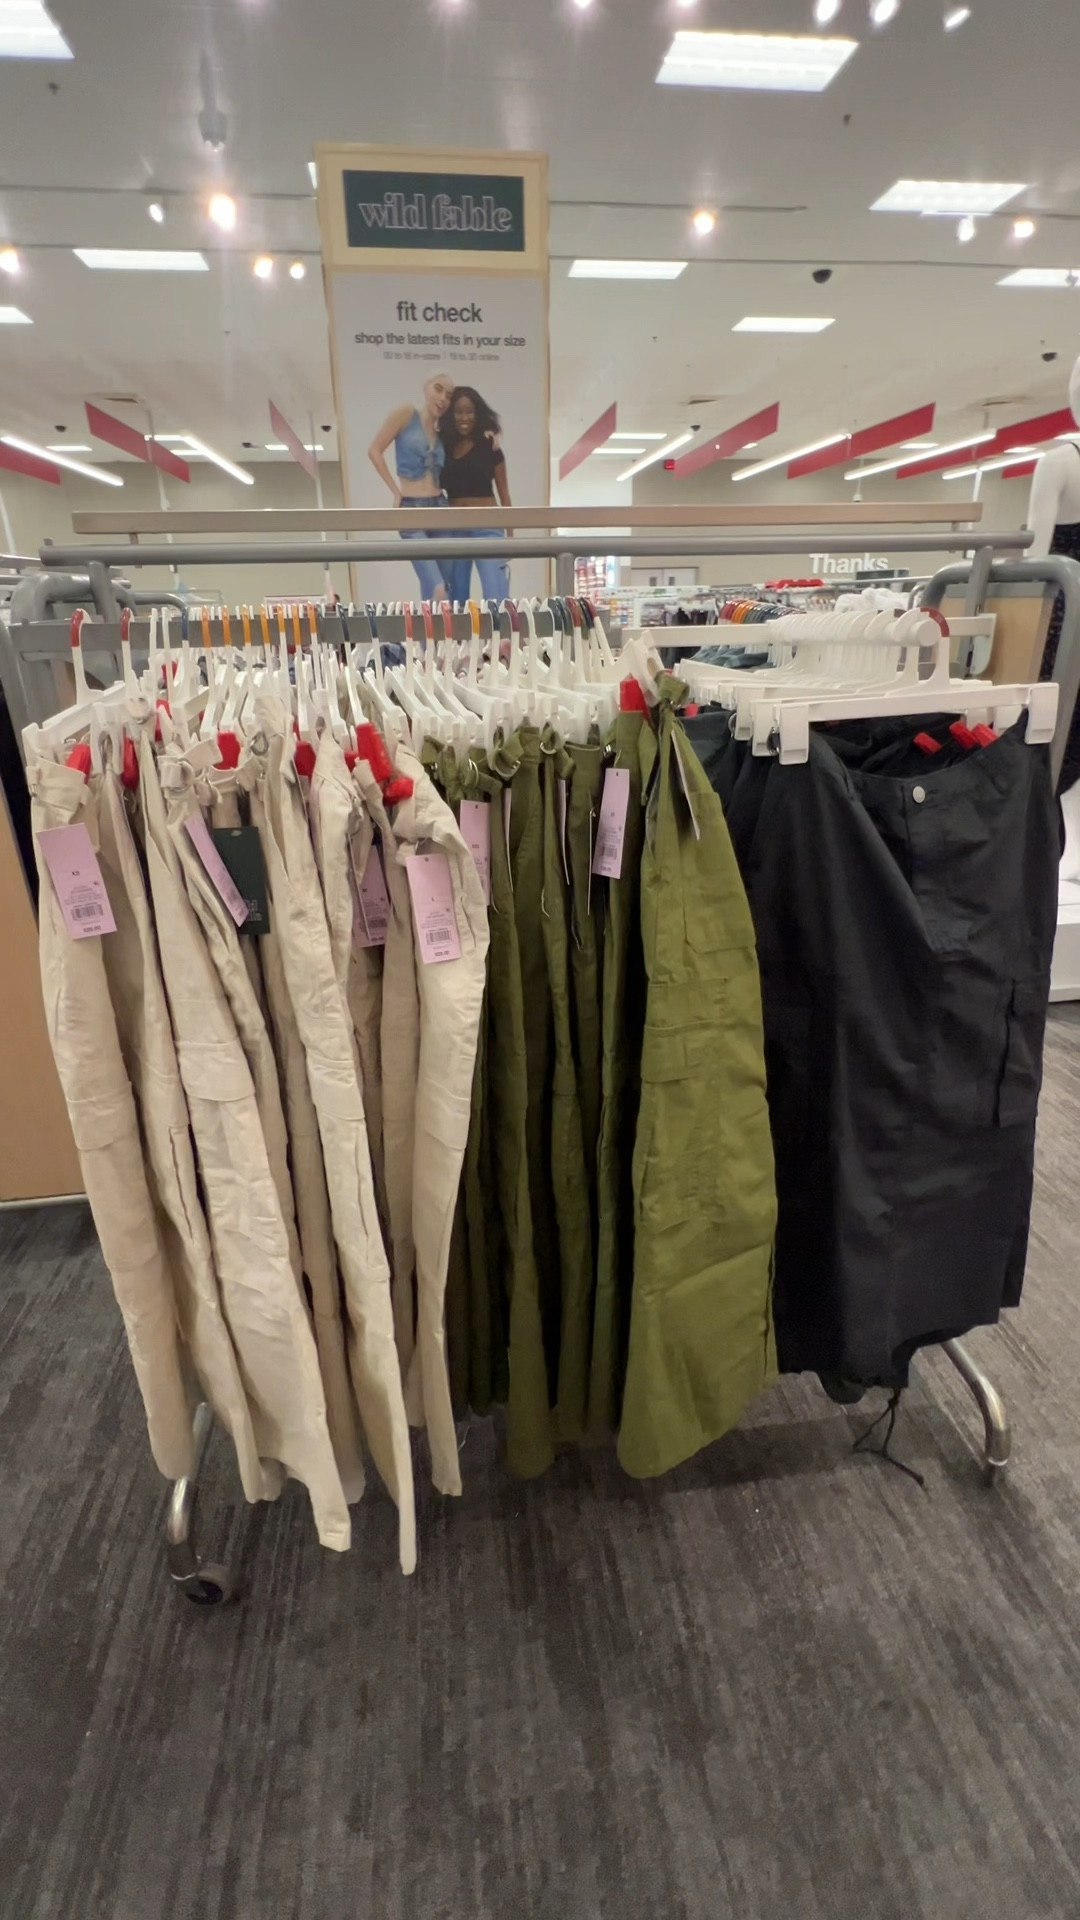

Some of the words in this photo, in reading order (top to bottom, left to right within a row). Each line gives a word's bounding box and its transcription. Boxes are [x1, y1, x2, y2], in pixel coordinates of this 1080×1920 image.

[358, 192, 428, 230] wild
[432, 194, 513, 232] fable
[396, 301, 418, 321] fit
[422, 303, 483, 323] check
[354, 332, 383, 346] shop
[386, 333, 405, 344] the
[408, 333, 440, 345] latest
[442, 333, 461, 345] fits
[463, 334, 474, 346] in
[475, 336, 501, 349] your
[503, 335, 526, 347] size
[808, 552, 889, 574] Thanks
